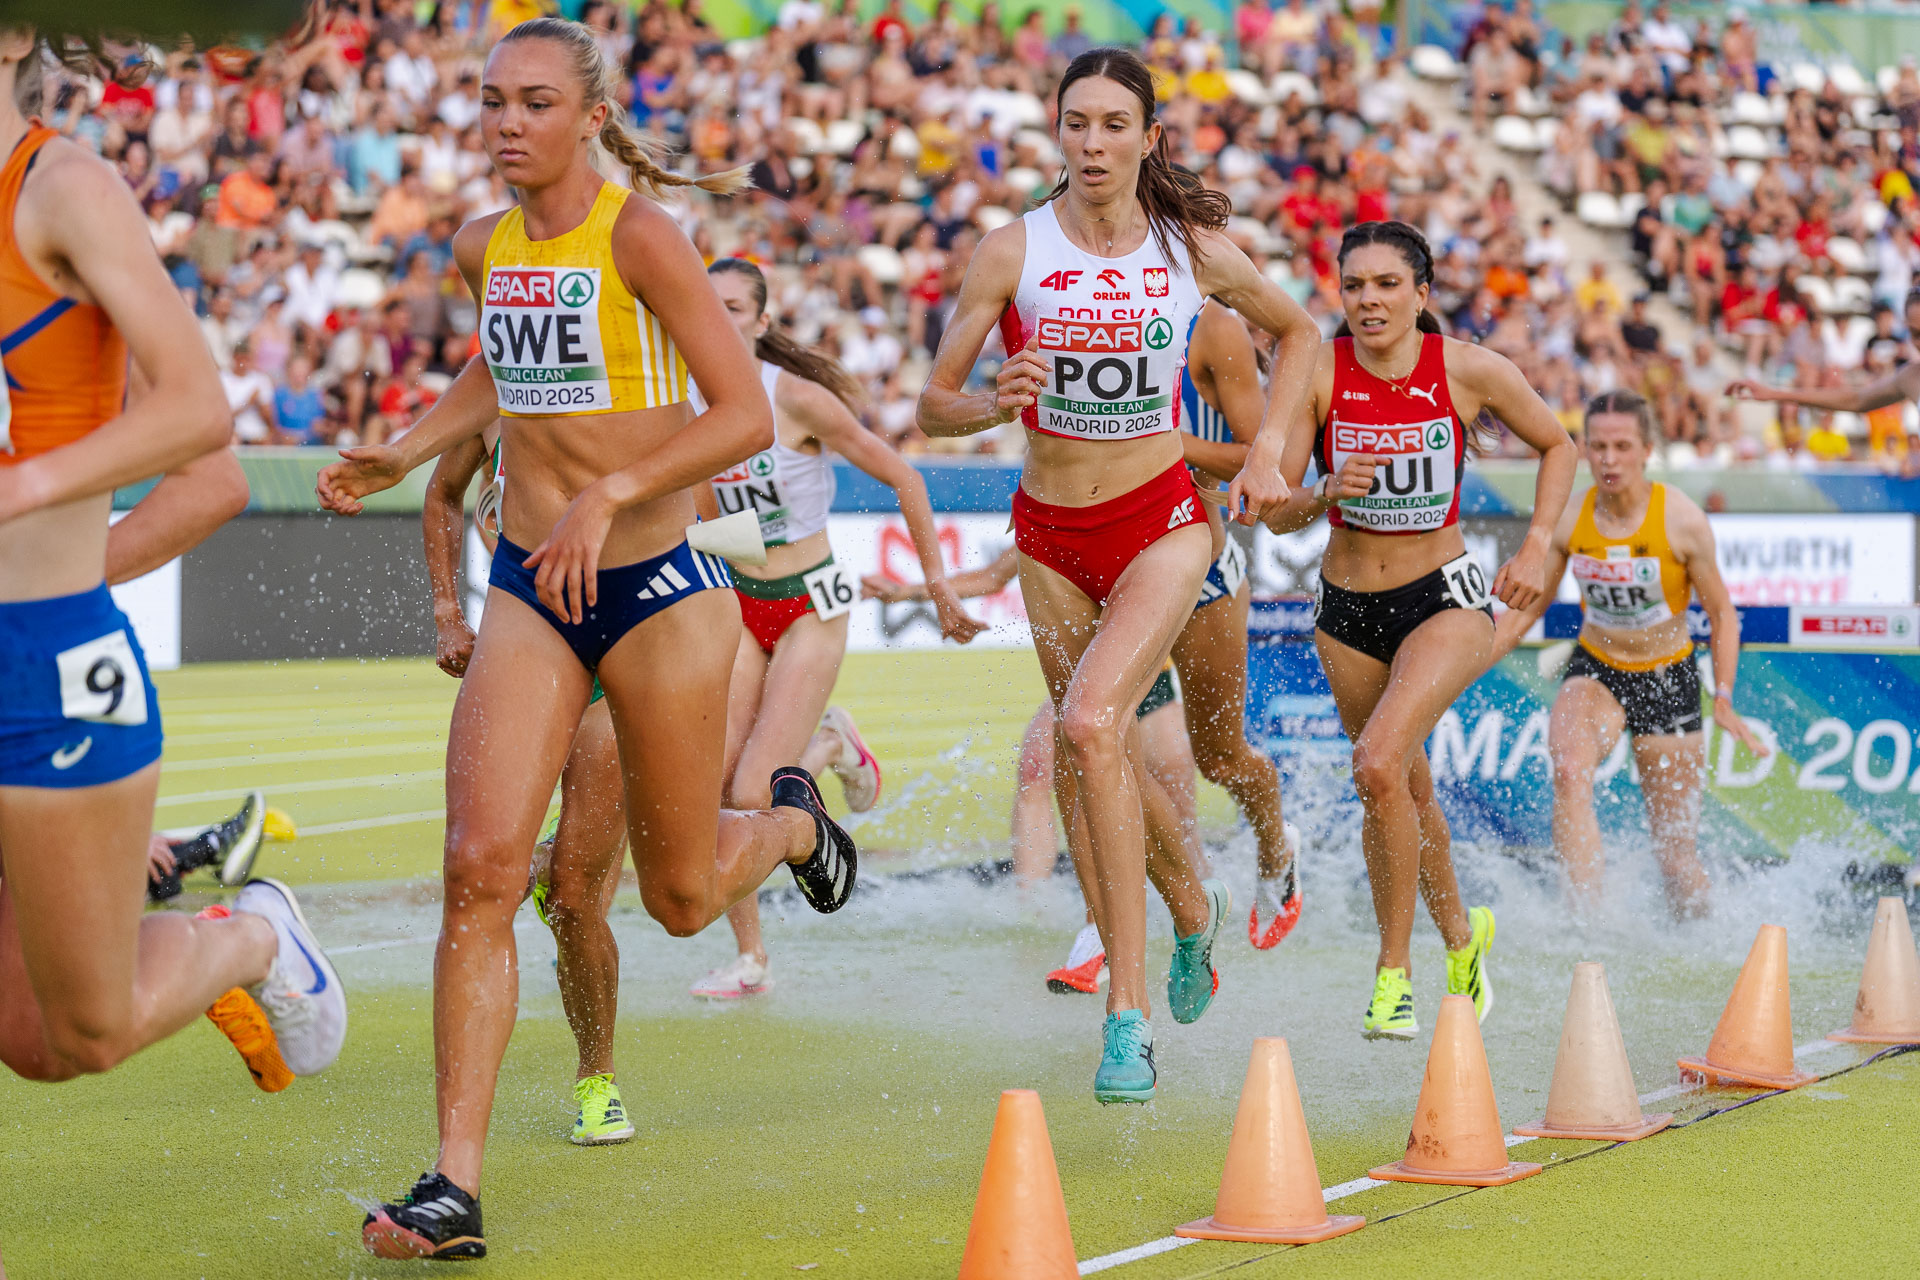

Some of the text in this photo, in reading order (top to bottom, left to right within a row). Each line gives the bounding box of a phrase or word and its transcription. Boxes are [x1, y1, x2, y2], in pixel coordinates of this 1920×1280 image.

[487, 275, 553, 303] SPAR
[1039, 270, 1084, 291] 4F
[1092, 291, 1131, 301] ORLEN
[487, 312, 589, 365] SWE
[1040, 323, 1140, 350] SPAR
[1054, 356, 1160, 401] POL
[545, 386, 595, 406] 2025
[1071, 402, 1099, 413] RUN
[1352, 391, 1371, 401] UBS
[1049, 412, 1162, 434] MADRID 2025
[1337, 428, 1422, 452] SPAR
[1368, 456, 1434, 496] UI
[1167, 495, 1195, 530] 4F
[1364, 499, 1389, 509] RUN
[1347, 508, 1448, 526] MADRID 2025
[813, 571, 853, 611] 16
[1450, 562, 1486, 605] 10
[1586, 583, 1650, 608] GER
[1819, 616, 1888, 634] SPAR
[86, 655, 124, 716] 9
[1429, 708, 1920, 796] MAID 20
